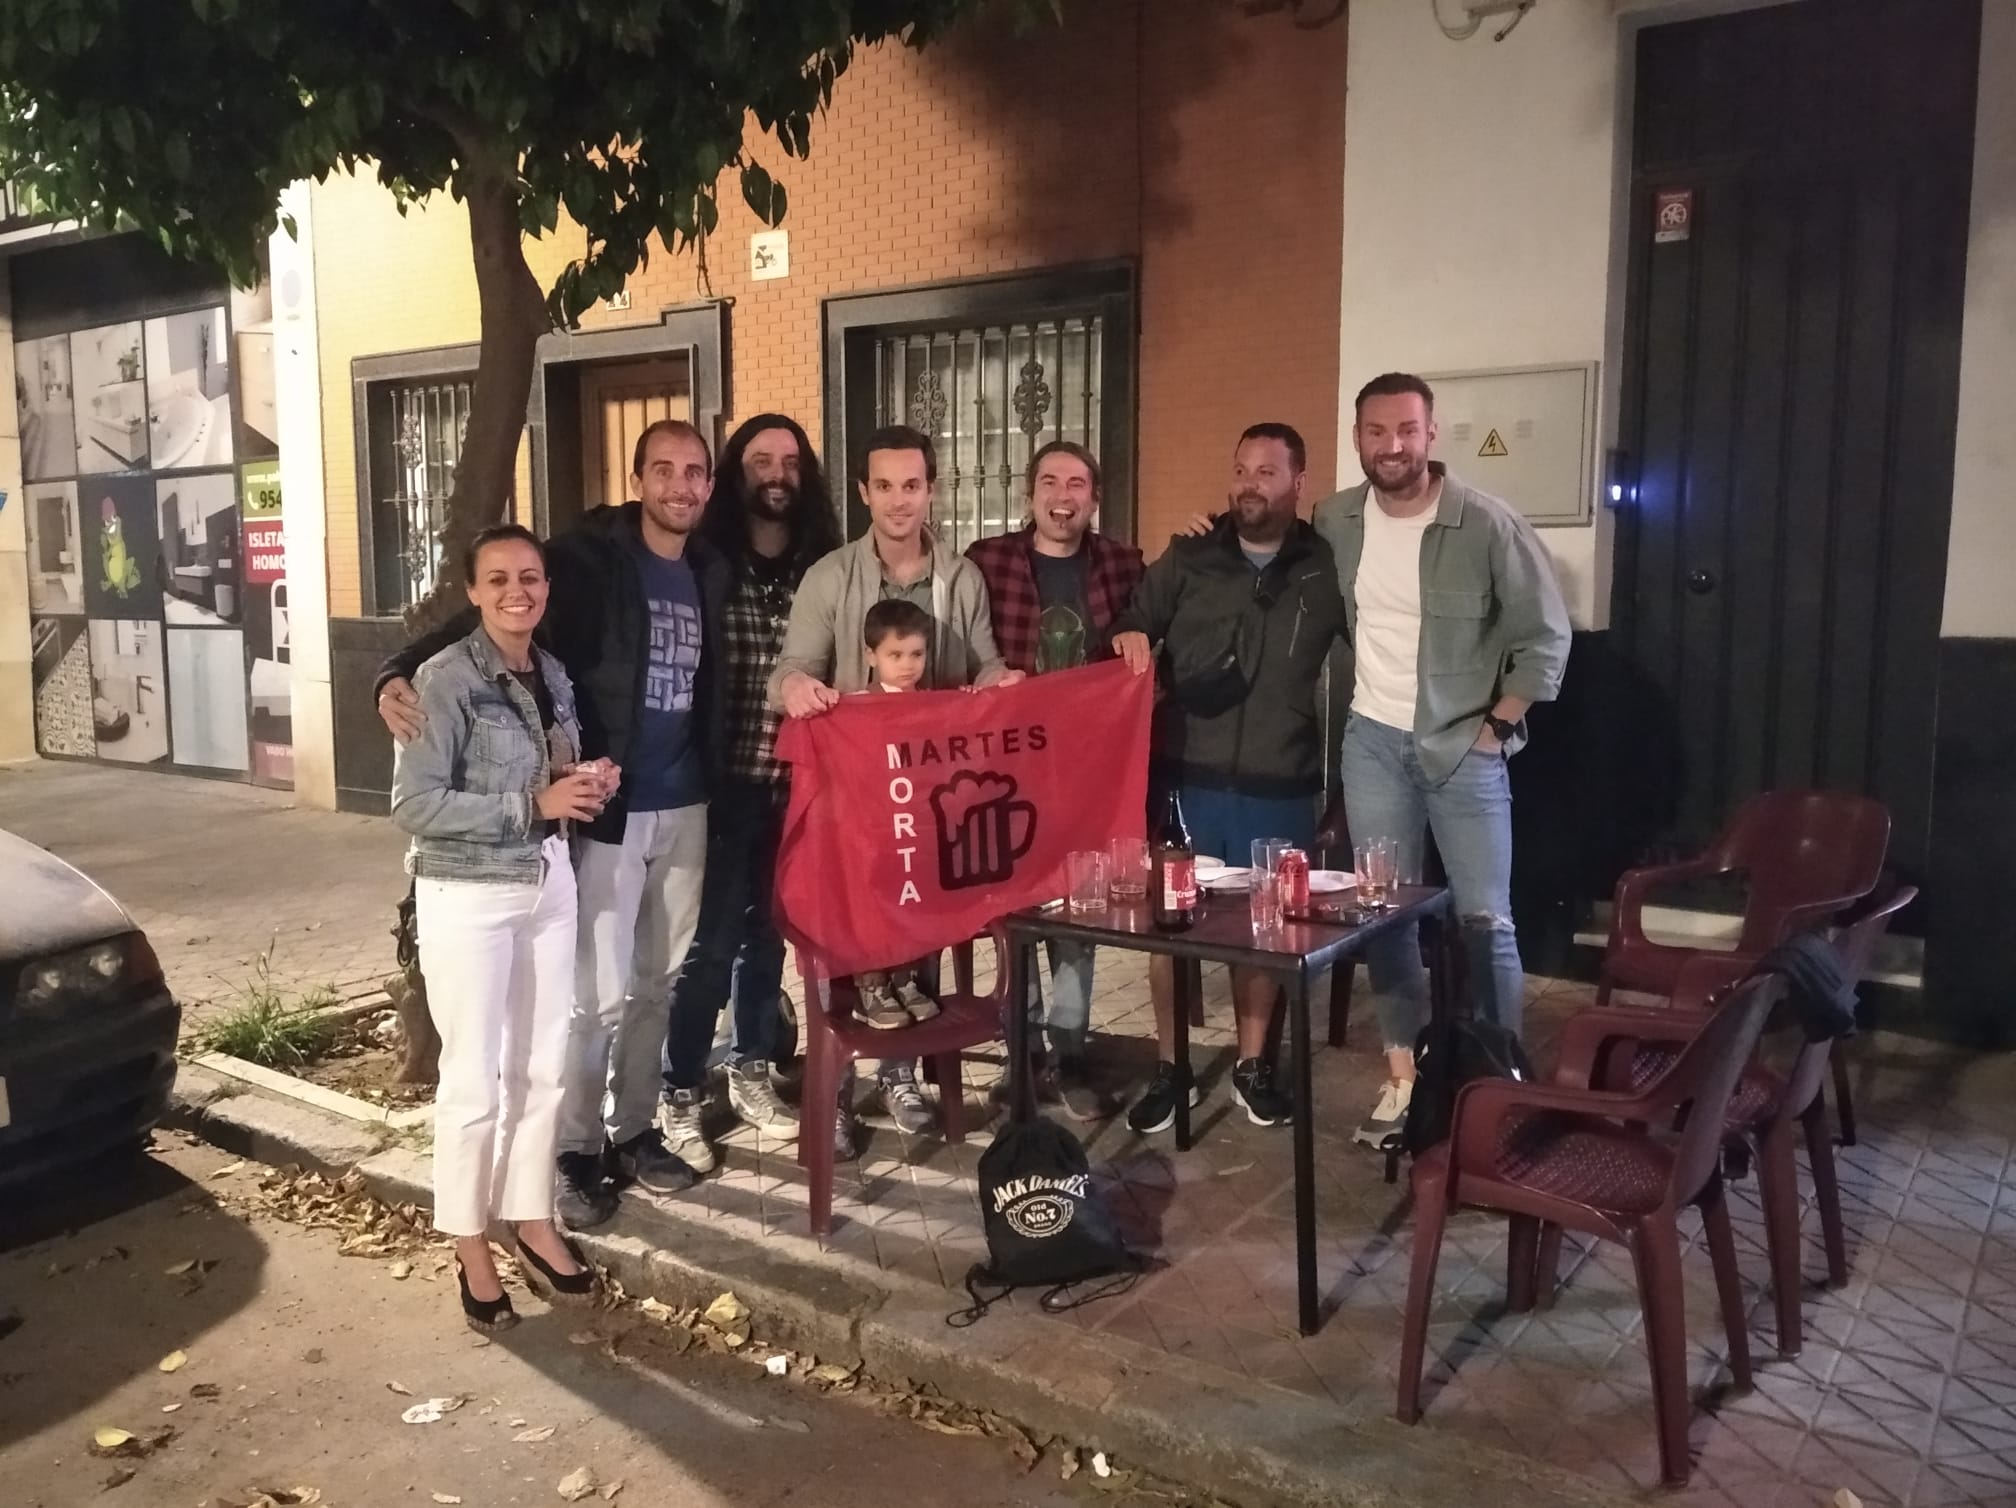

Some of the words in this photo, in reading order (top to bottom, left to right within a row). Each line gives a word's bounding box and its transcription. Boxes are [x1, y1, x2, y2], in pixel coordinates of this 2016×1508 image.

[886, 724, 1048, 769] MARTES
[886, 743, 922, 906] MORTA
[993, 1178, 1028, 1213] JACK
